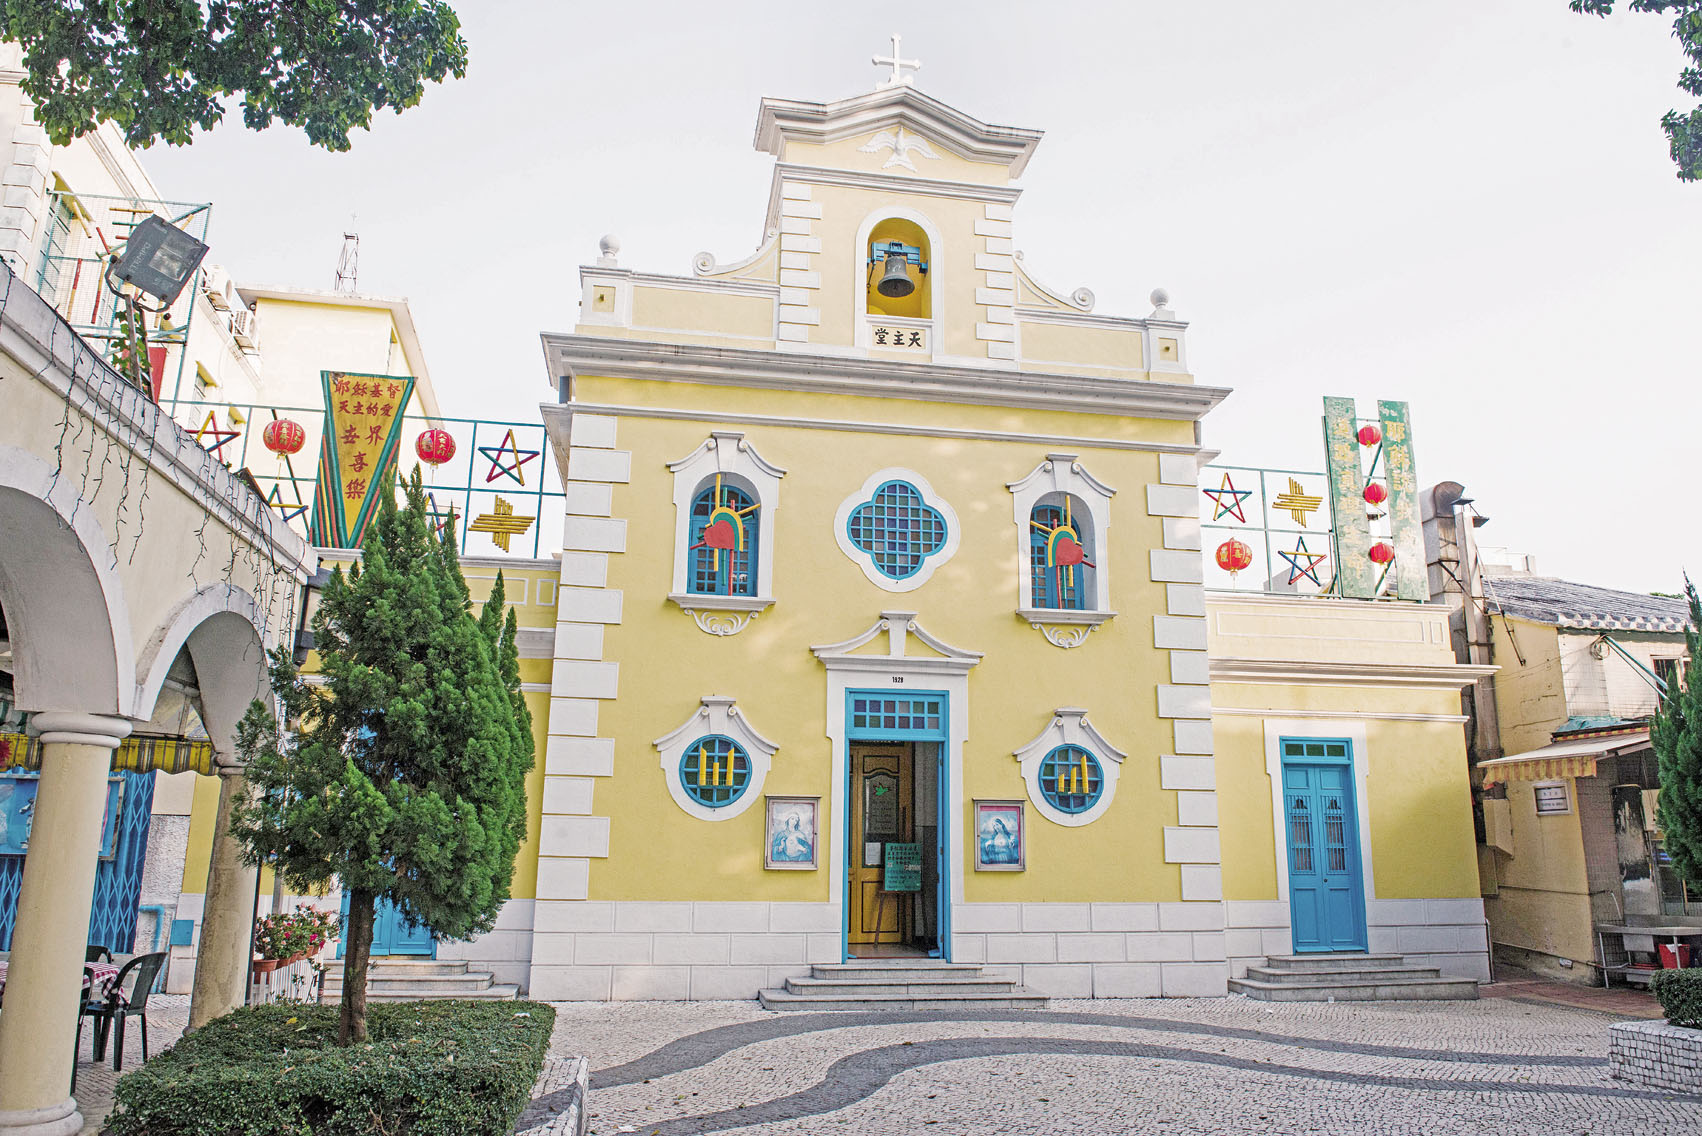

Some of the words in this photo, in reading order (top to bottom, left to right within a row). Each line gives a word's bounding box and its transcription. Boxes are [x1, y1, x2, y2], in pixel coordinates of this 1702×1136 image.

[874, 327, 922, 348] 天主堂
[334, 378, 401, 400] 耶穌基督
[337, 400, 394, 417] 天主的愛
[348, 451, 369, 473] 喜
[345, 478, 366, 500] 樂
[892, 676, 904, 684] 1928
